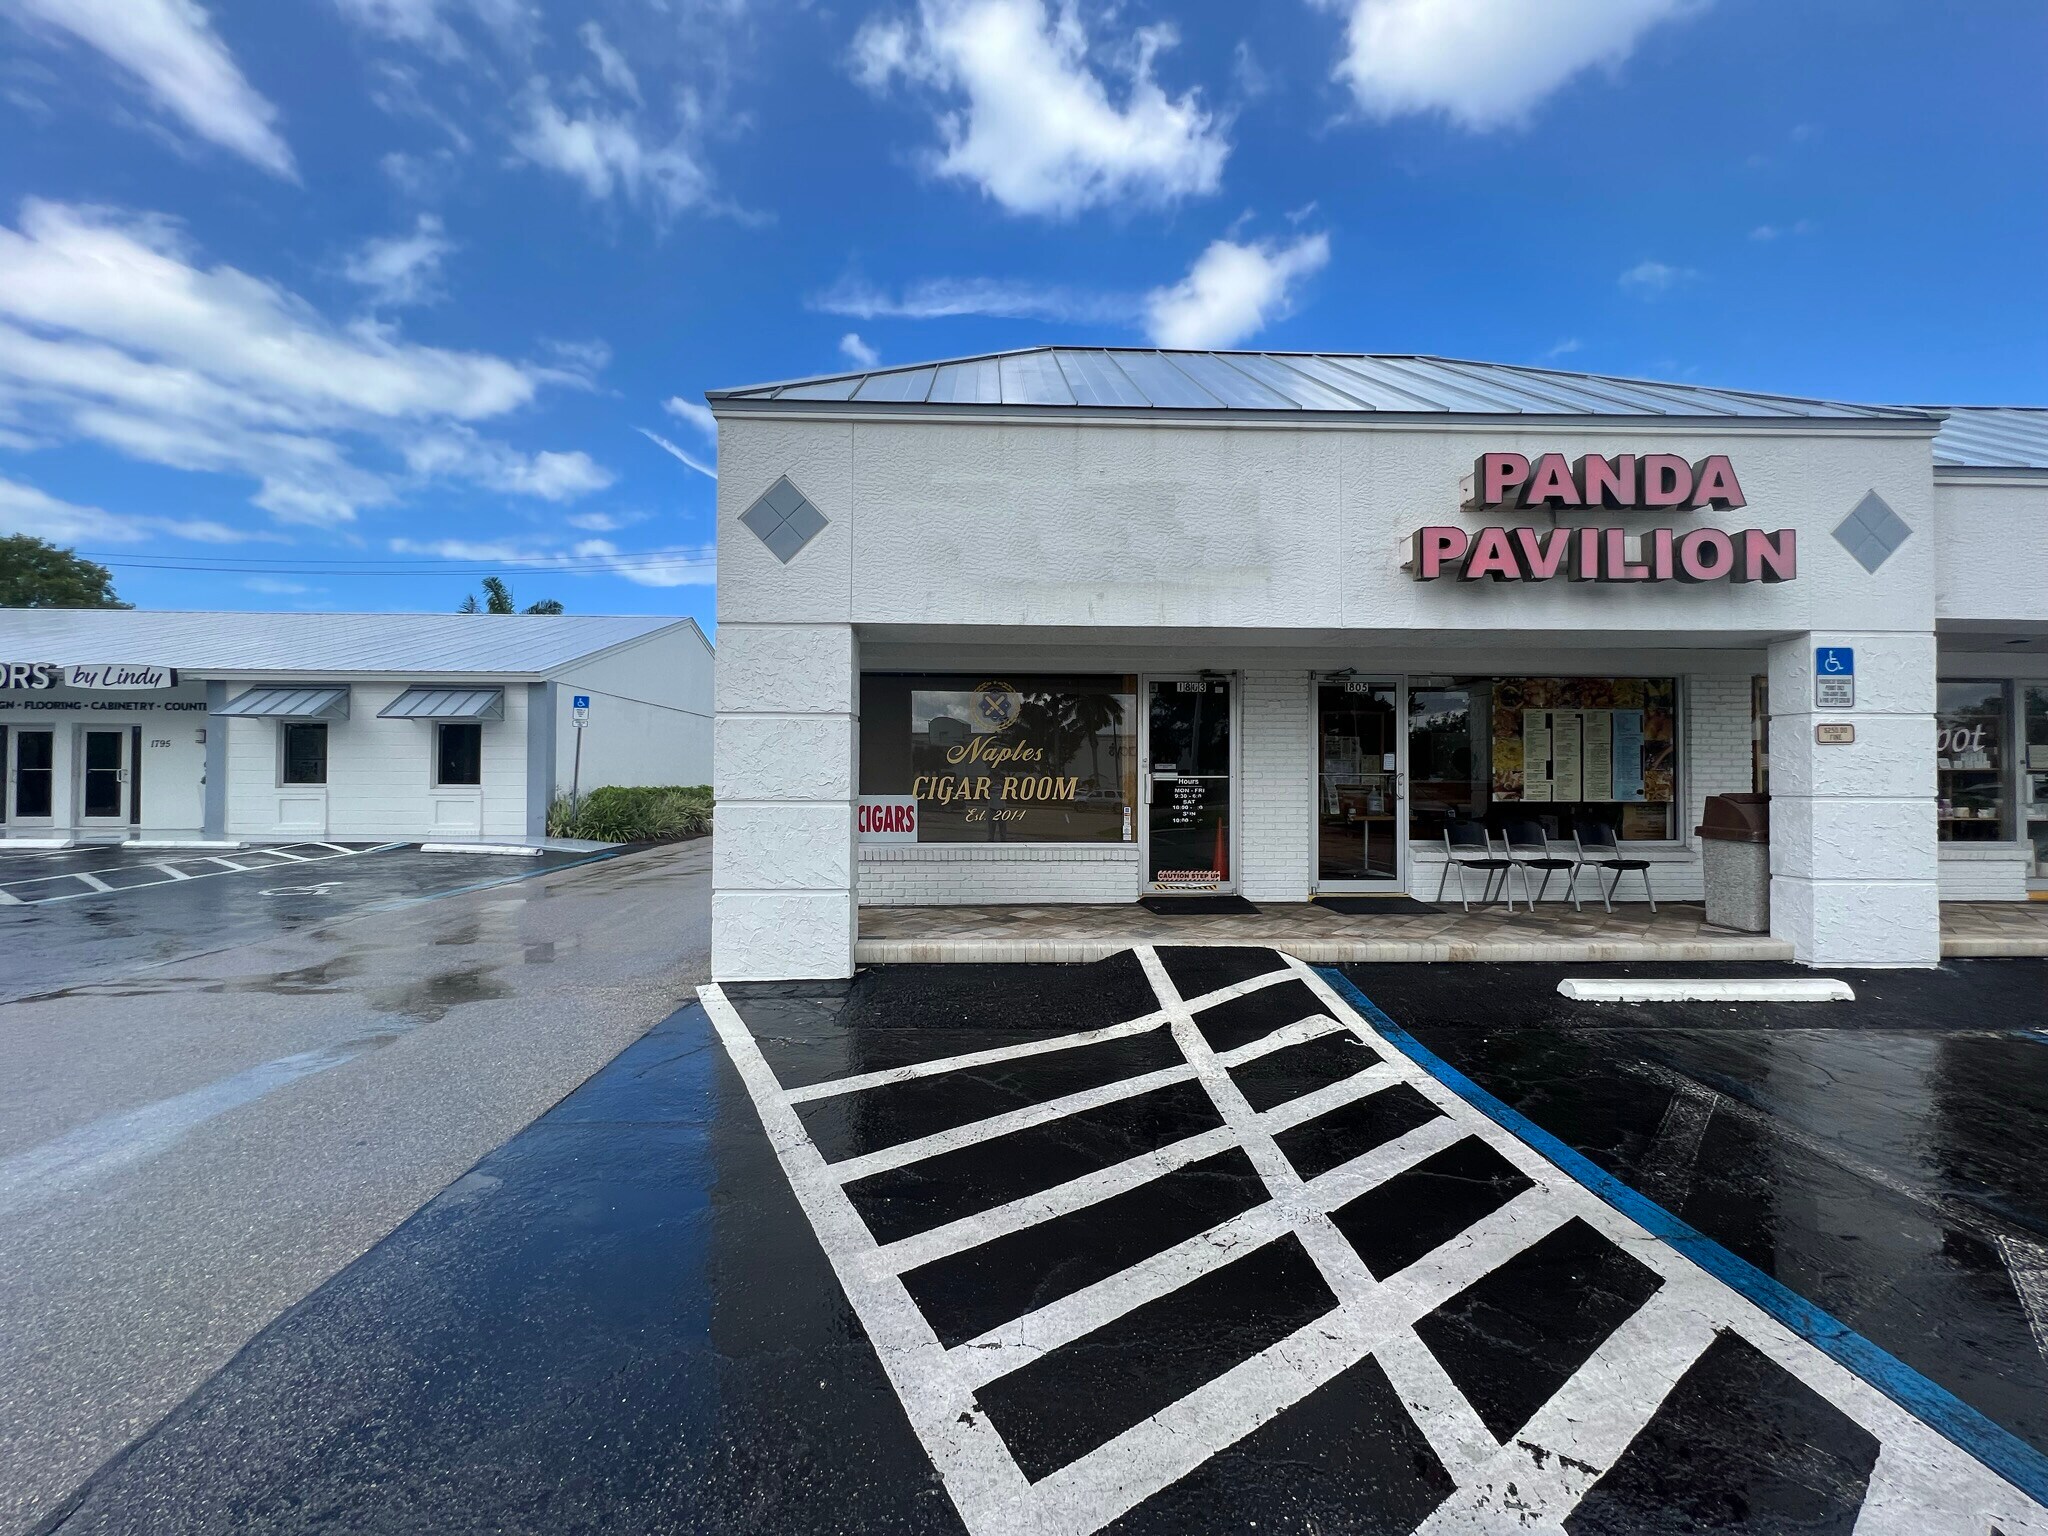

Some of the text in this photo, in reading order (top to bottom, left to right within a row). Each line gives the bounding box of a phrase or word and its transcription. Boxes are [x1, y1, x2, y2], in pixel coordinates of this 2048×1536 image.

[1478, 452, 1747, 510] PANDA
[1416, 526, 1797, 581] PAVILION
[72, 666, 163, 687] by Lindy
[1345, 683, 1369, 692] 1805
[24, 701, 81, 710] FLOORING
[91, 702, 153, 711] CABINETRY
[151, 740, 171, 748] 1795
[946, 735, 1043, 768] Naples
[912, 776, 1078, 806] CIGAR ROOM
[859, 804, 915, 833] CIGARS
[992, 809, 1026, 821] 2014
